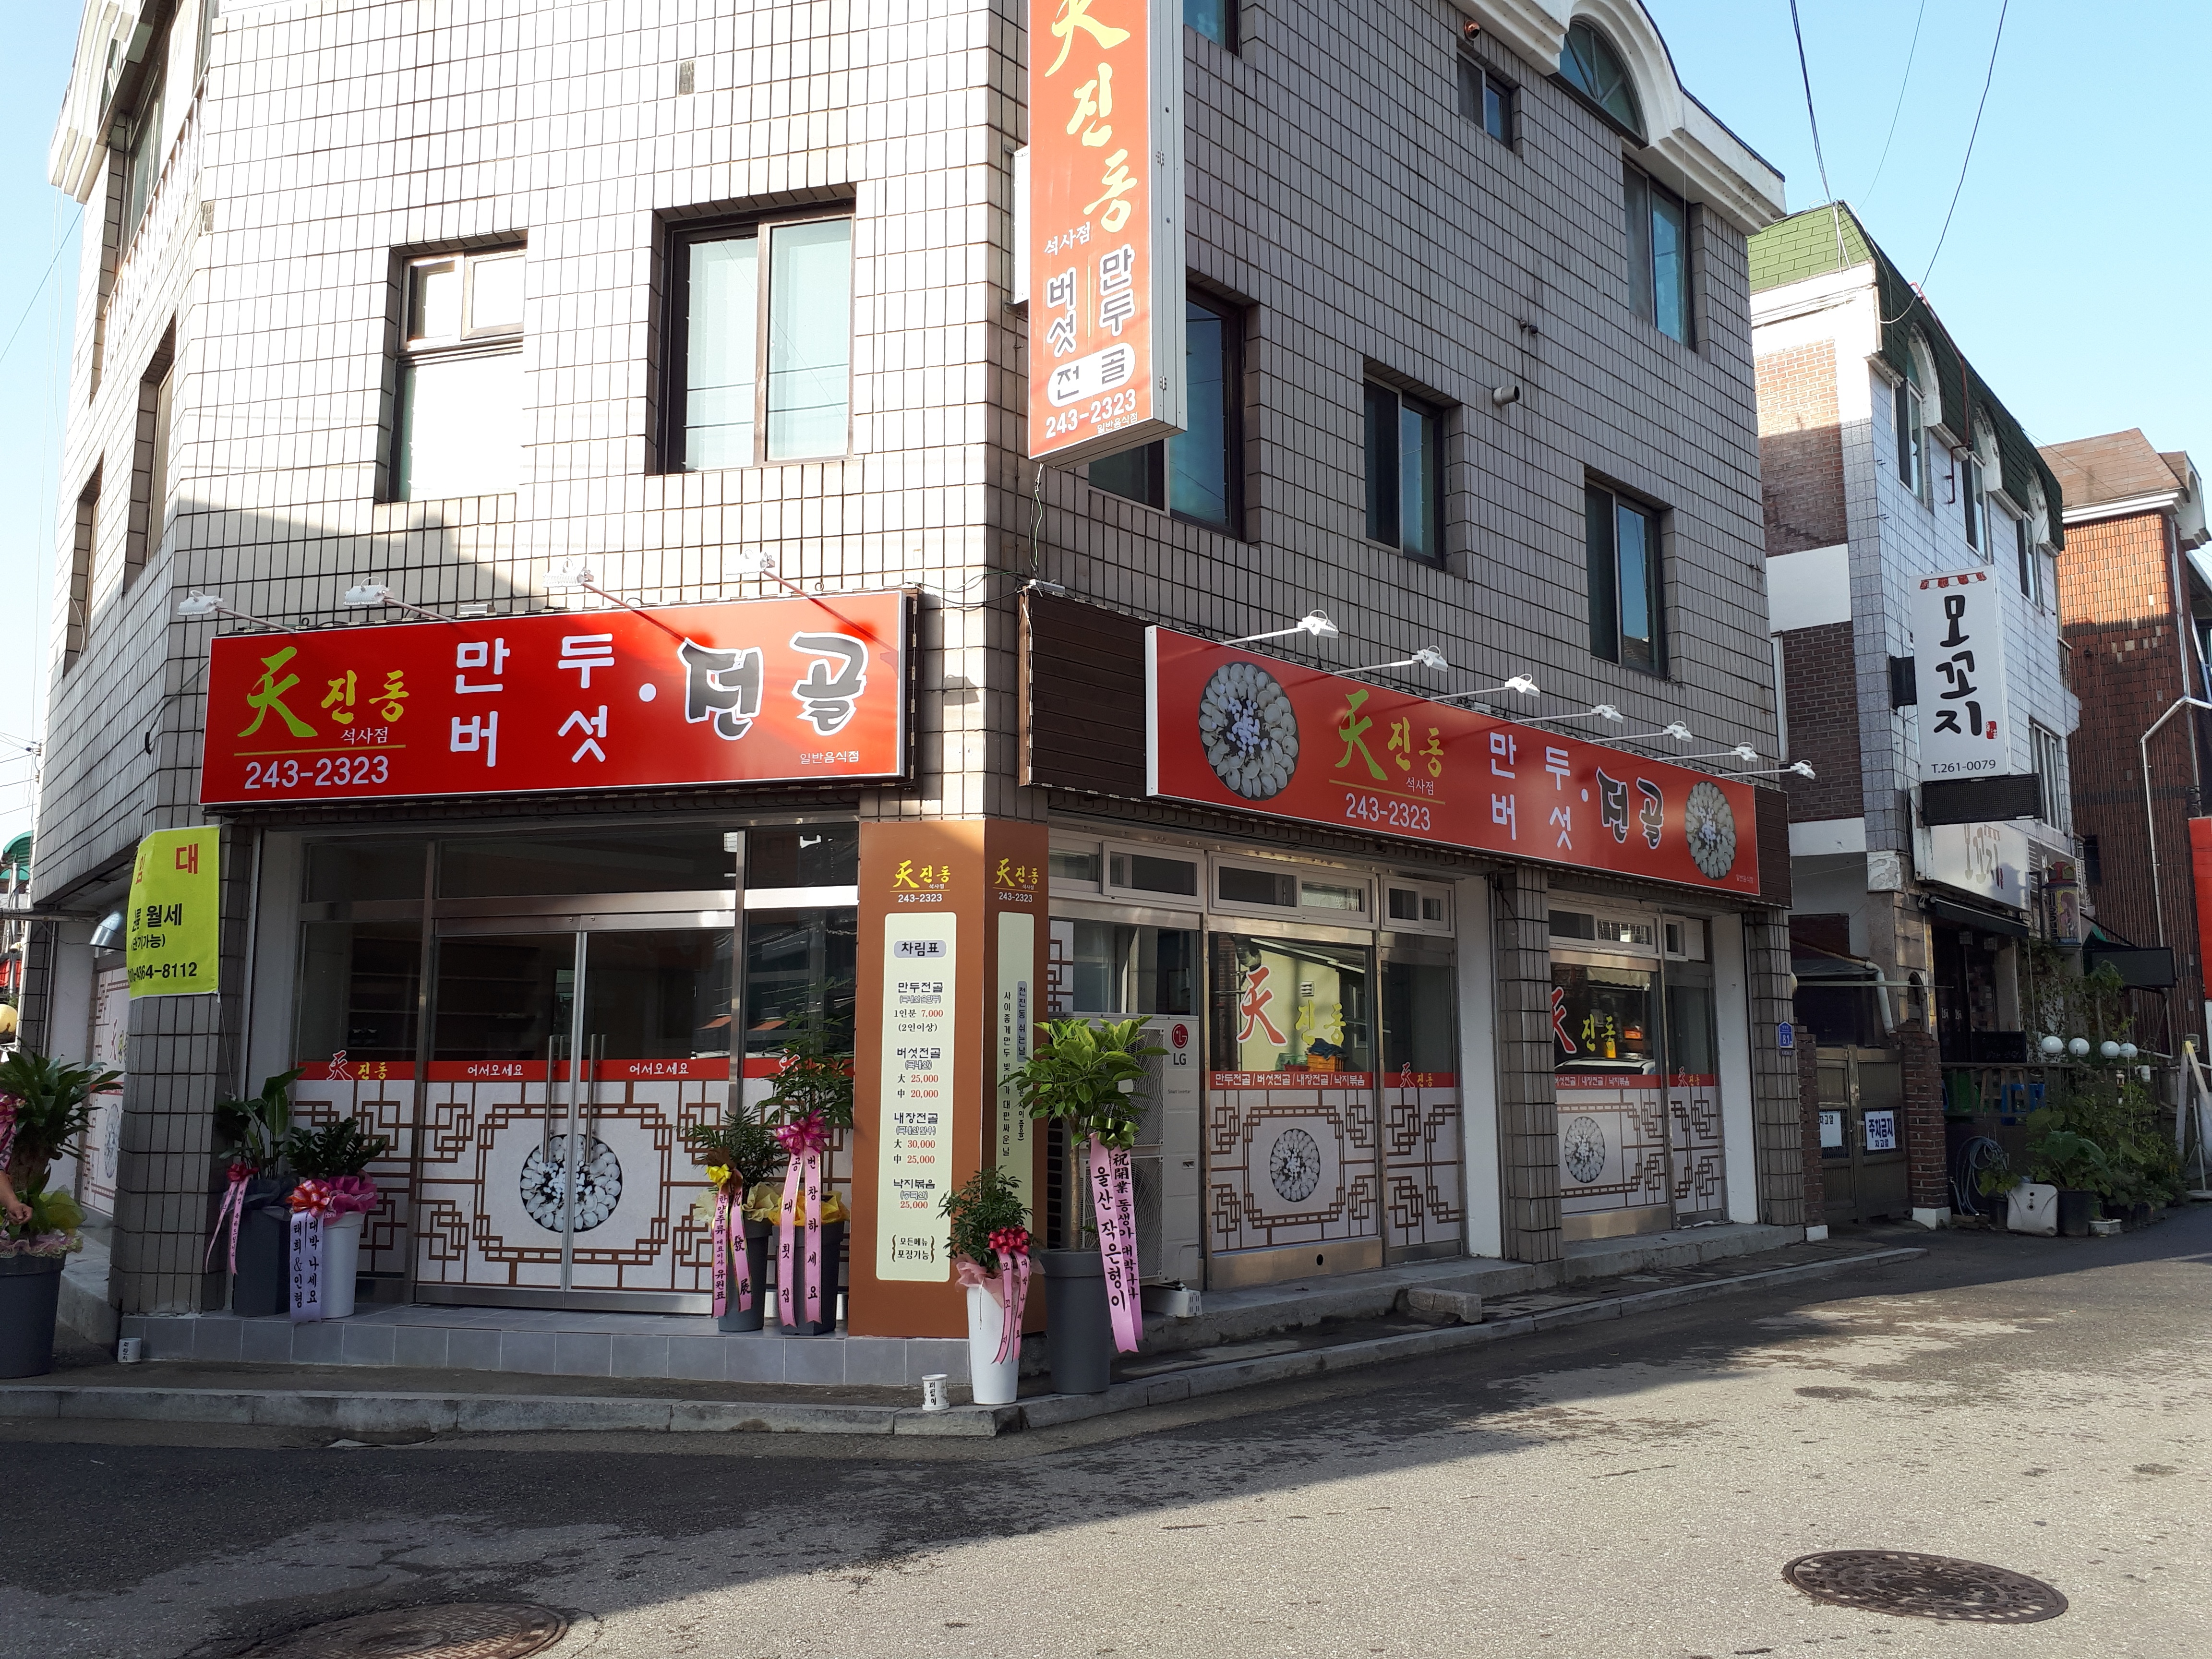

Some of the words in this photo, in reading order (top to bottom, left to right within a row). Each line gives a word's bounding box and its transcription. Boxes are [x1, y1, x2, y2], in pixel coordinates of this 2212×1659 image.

[1044, 222, 1090, 255] 석사점
[1099, 244, 1135, 337] 만두
[1046, 267, 1077, 358] 버섯
[1058, 348, 1124, 400] 전골
[1046, 388, 1136, 439] 243-2323
[1097, 412, 1138, 433] 일반음식점
[1934, 595, 1982, 736] 모꼬지
[340, 727, 388, 745] 석사점
[800, 750, 860, 765] 일반음식점
[244, 756, 389, 789] 243-2323
[1931, 759, 1996, 774] T.261-0079
[1406, 777, 1433, 795] 석사점
[1346, 793, 1431, 830] 243-2323
[898, 893, 942, 902] 243-2323
[999, 891, 1033, 902] 243-2323
[146, 903, 182, 928] 월세
[901, 941, 939, 956] 차림표
[898, 982, 943, 993] 만두전골
[894, 1009, 916, 1018] 1인분
[921, 1010, 943, 1018] 7,000
[898, 1023, 938, 1032] (2인이상)
[897, 1047, 941, 1059] 버섯전골
[1173, 1053, 1186, 1065] LG
[468, 1063, 523, 1076] 어서오세요
[629, 1062, 689, 1076] 어서오세요
[905, 1060, 932, 1070] (국내산)
[897, 1074, 906, 1083] 大
[911, 1074, 938, 1083] 25,000
[1215, 1073, 1251, 1086] 만두전골
[1257, 1073, 1290, 1086] 버섯전골
[1297, 1073, 1329, 1086] 내장전골
[1334, 1074, 1365, 1086] 낙지볶음
[897, 1088, 905, 1098] 中
[911, 1090, 938, 1098] 20,000
[894, 1112, 938, 1124] 내장전골
[1869, 1118, 1893, 1138] 주차금지
[894, 1139, 902, 1149] 大
[907, 1140, 936, 1149] 30,000
[1875, 1138, 1889, 1148] 차고앞
[894, 1154, 901, 1164] 中
[907, 1155, 935, 1164] 25,000
[1112, 1153, 1131, 1194] 祝開業
[893, 1178, 935, 1189] 낙지볶음
[1094, 1166, 1113, 1211] 울산
[900, 1190, 928, 1200] (중국산)
[900, 1201, 928, 1209] 25,000
[715, 1194, 728, 1235] 한양주류
[1116, 1199, 1134, 1239] 동생아
[309, 1217, 320, 1250] 대박
[807, 1155, 818, 1300] 번창하세요
[900, 1238, 928, 1246] 모든메뉴
[898, 1250, 929, 1260] 포장가능
[1101, 1219, 1126, 1312] 작은형이
[715, 1269, 726, 1300] 유원표
